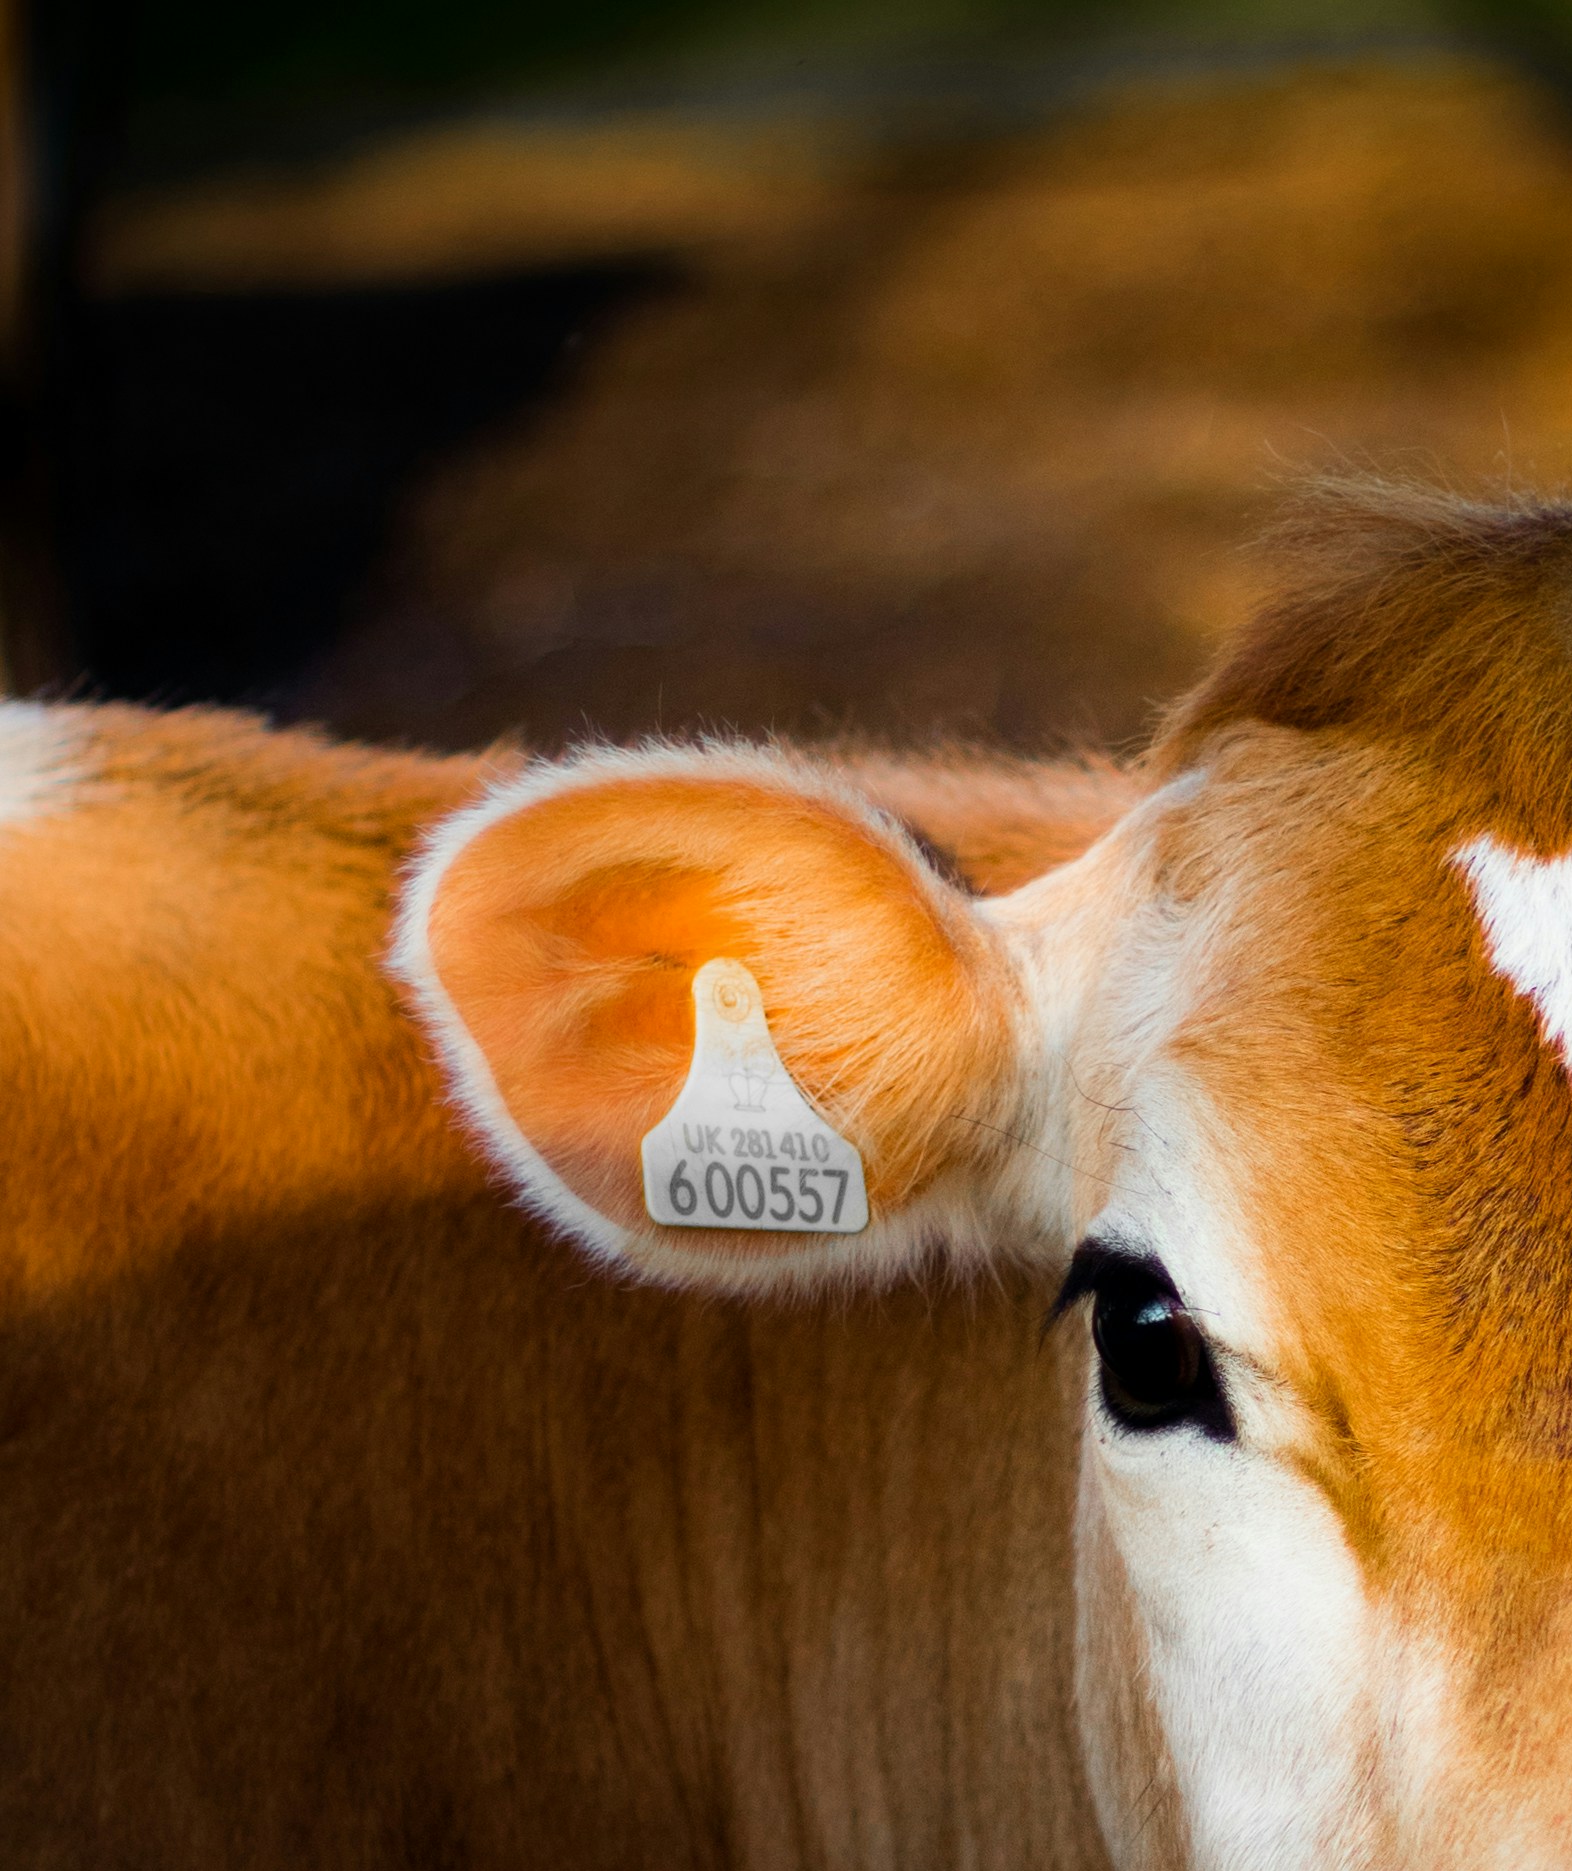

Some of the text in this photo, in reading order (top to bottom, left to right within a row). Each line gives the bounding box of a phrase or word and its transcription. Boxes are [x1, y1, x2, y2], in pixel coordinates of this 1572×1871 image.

[683, 1123, 830, 1163] UK 281410
[669, 1159, 849, 1225] 600557
